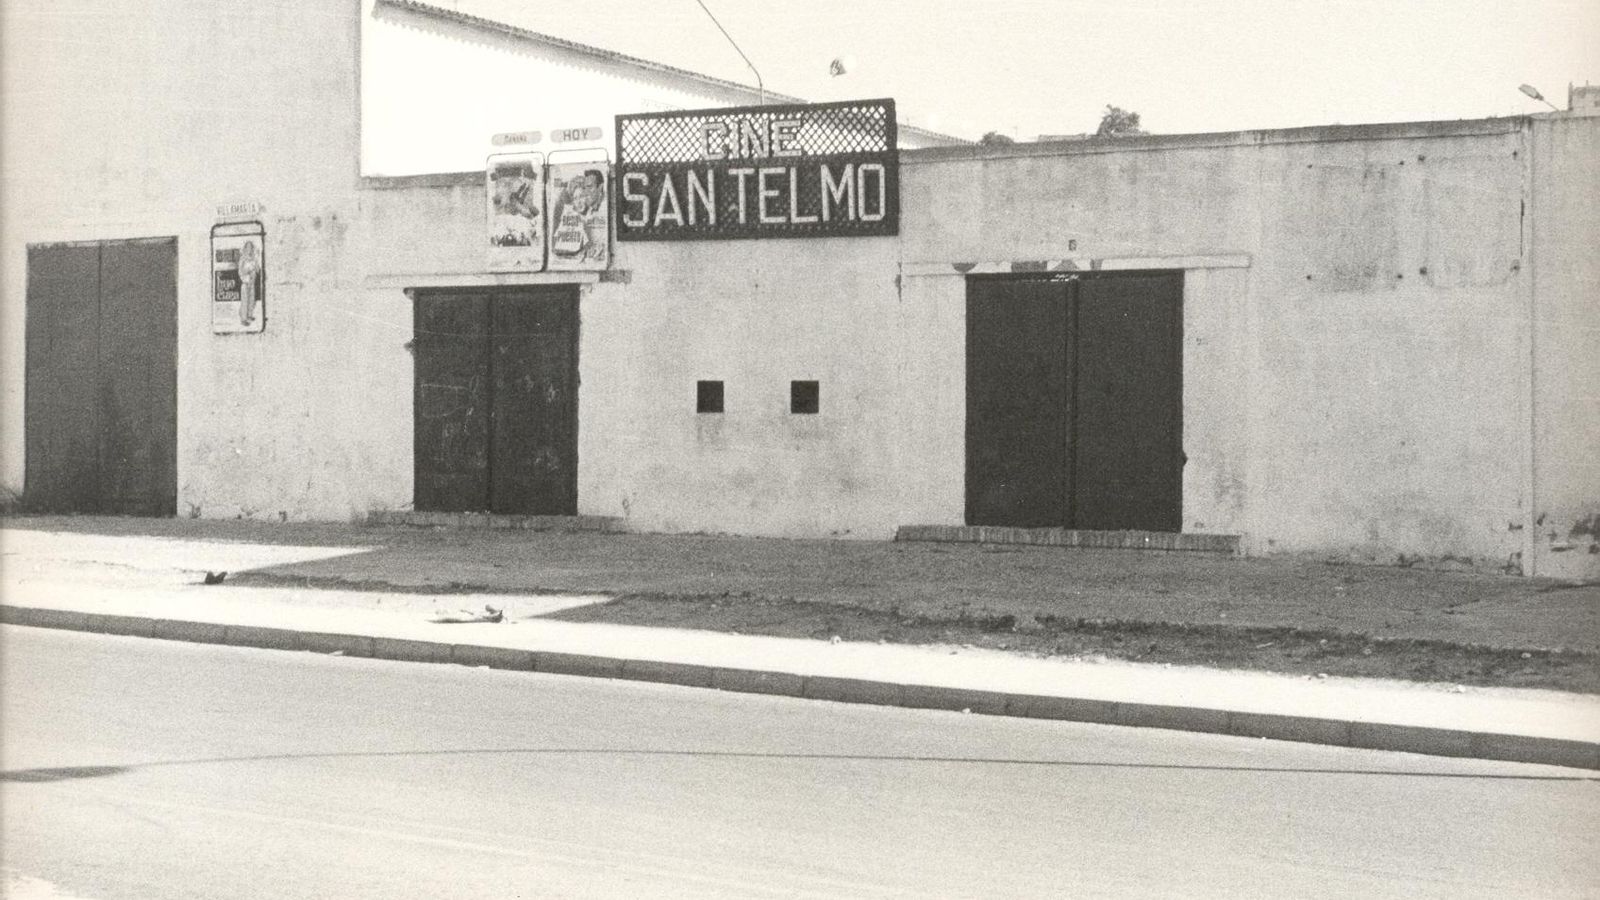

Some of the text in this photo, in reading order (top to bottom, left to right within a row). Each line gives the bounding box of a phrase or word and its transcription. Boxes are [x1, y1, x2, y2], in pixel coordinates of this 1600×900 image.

[563, 128, 589, 141] HOY
[700, 119, 802, 161] CINE
[623, 163, 886, 227] SAN TELMO
